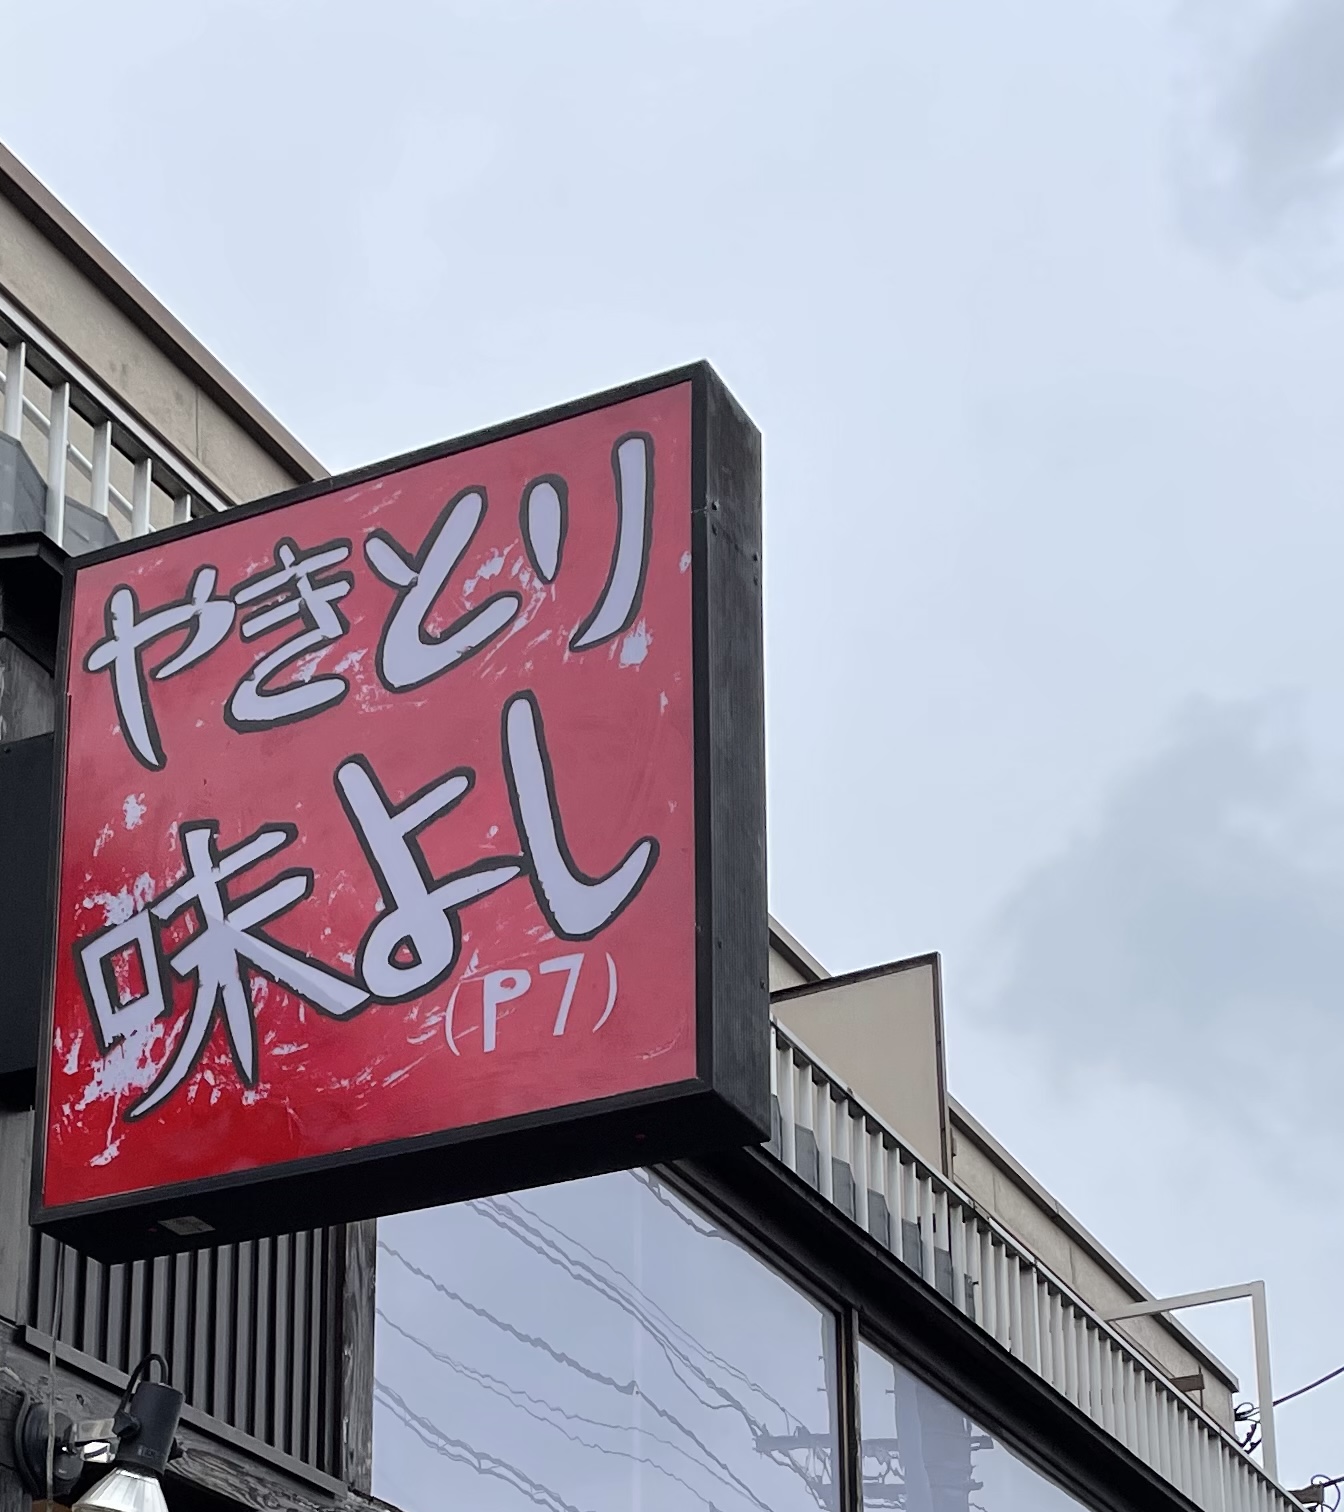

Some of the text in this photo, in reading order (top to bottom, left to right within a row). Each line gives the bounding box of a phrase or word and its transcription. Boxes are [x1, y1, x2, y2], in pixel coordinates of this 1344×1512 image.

[86, 431, 654, 770] やきとり
[78, 690, 660, 1122] 味よし
[443, 950, 618, 1056] (P7)
